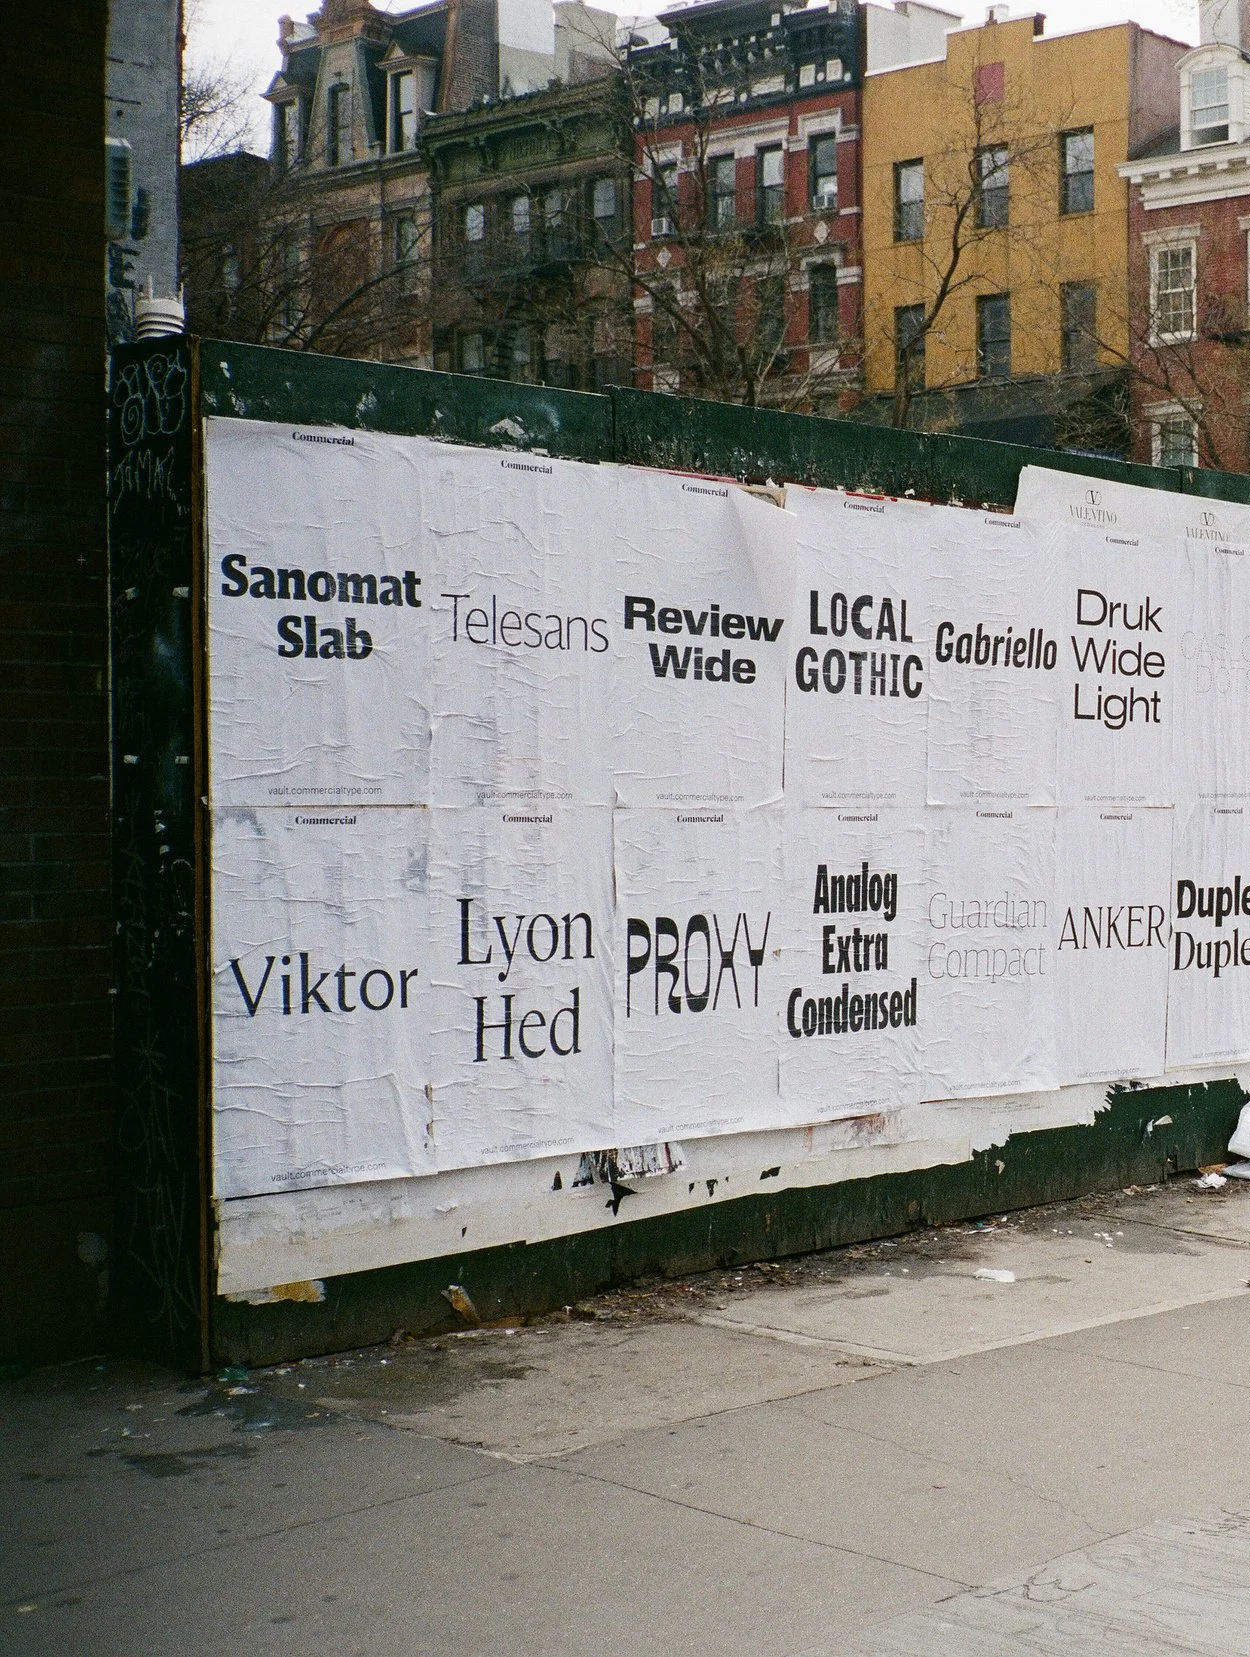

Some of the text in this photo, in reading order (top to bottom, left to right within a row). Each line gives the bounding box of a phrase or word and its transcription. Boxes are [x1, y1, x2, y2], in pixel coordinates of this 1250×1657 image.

[292, 431, 354, 446] Commercial
[501, 459, 553, 474] Commercial
[682, 483, 728, 498] Commercial
[843, 500, 885, 514] Commercial
[1069, 504, 1117, 524] VALENTINO
[984, 517, 1021, 529] Commercial
[1105, 535, 1139, 547] Commercial
[1186, 526, 1229, 543] VALENTINO
[1215, 546, 1245, 556] Commercial
[221, 554, 421, 608] Sanomat
[624, 595, 784, 643] Review
[810, 590, 913, 644] LOCAL
[1076, 588, 1162, 632] Druk
[440, 593, 609, 652] Telesans
[277, 615, 373, 660] Slab
[935, 621, 1057, 671] Gabriello
[649, 642, 756, 684] Wide
[1070, 635, 1165, 678] Wide
[795, 646, 923, 699] GOTHIC
[1074, 683, 1161, 730] Light
[268, 785, 382, 797] vault.commercialtype.com
[476, 790, 573, 801] vault.commercialtype.com
[656, 792, 744, 803] vault.commercialtype.com
[821, 791, 896, 801] vault.commercialtype.com
[960, 791, 1029, 800] vault.commercialtype.com
[295, 815, 357, 826] Commercial
[502, 813, 553, 824] Commercial
[676, 813, 724, 824] Commercial
[837, 813, 878, 823] Commercial
[976, 810, 1013, 820] Commercial
[1100, 812, 1133, 822] Commercial
[813, 861, 898, 922] Analog
[928, 891, 1048, 930] Guardian
[1057, 904, 1167, 951] ANKER
[456, 898, 595, 982] Lyon
[822, 925, 888, 975] Extra
[626, 911, 771, 1018] PROXY
[928, 942, 1046, 984] Compact
[228, 952, 418, 1018] Viktor
[786, 977, 917, 1039] Condensed
[472, 987, 582, 1062] Hed
[950, 1079, 1021, 1093] vault.commercialtype.com
[816, 1097, 891, 1114] vault.commercialtype.com
[657, 1116, 745, 1135] vault.commercialtype.com
[481, 1136, 575, 1156] vault.commercialtype.com
[271, 1162, 386, 1183] vault.commercialtype.com
